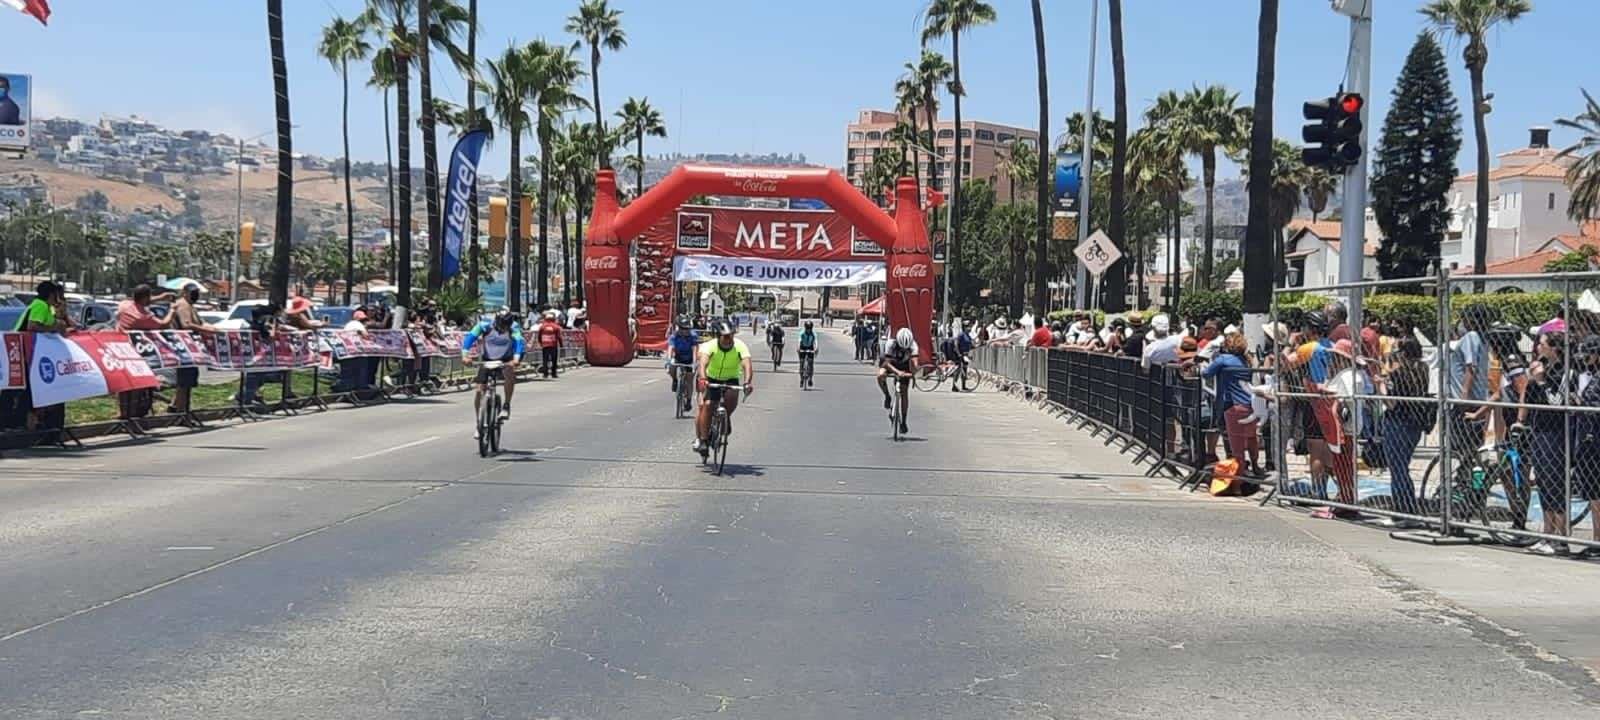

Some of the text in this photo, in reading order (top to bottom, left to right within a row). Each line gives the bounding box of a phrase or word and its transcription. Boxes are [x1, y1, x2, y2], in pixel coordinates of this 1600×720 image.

[447, 151, 476, 232] telcel
[734, 220, 833, 251] META
[710, 264, 729, 277] 26
[734, 265, 754, 278] DE
[759, 266, 809, 280] JUNIO
[815, 267, 850, 280] 2021
[56, 359, 94, 376] Calimax
